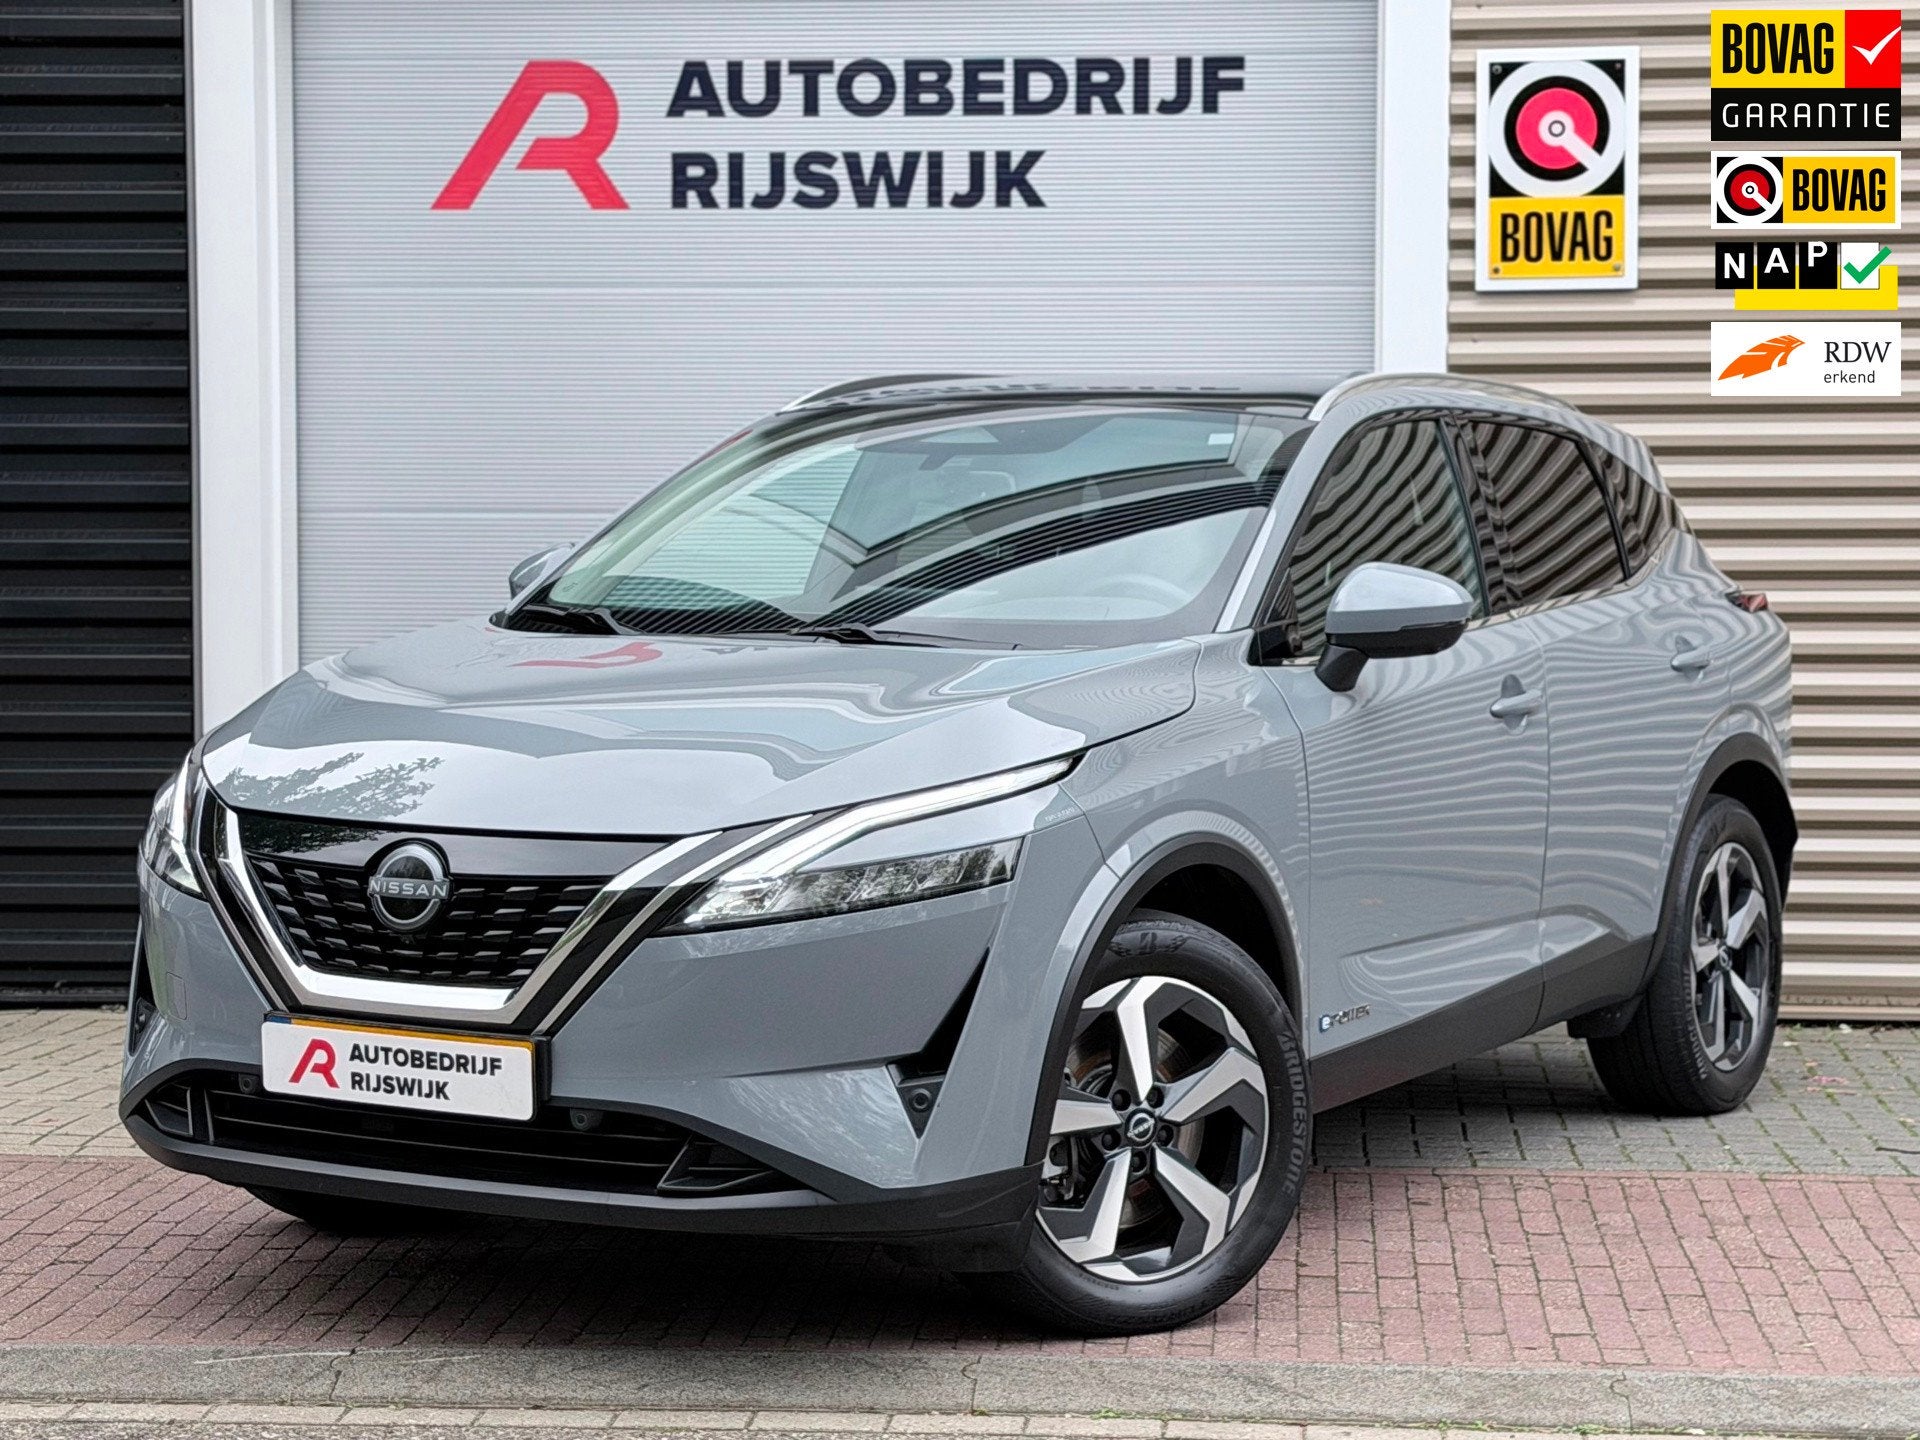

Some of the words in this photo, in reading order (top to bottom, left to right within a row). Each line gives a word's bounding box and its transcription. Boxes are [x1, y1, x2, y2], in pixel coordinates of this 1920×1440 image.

[666, 56, 1245, 118] AUTOBEDRIJF
[671, 150, 1045, 209] RIJSWIJK
[1500, 209, 1613, 263] BOVAG
[369, 879, 447, 897] NISSAN
[349, 1042, 503, 1077] AUTOBEDRIJF
[350, 1072, 451, 1102] RIJSWIJK
[1277, 1032, 1307, 1197] BRIDGESTONE
